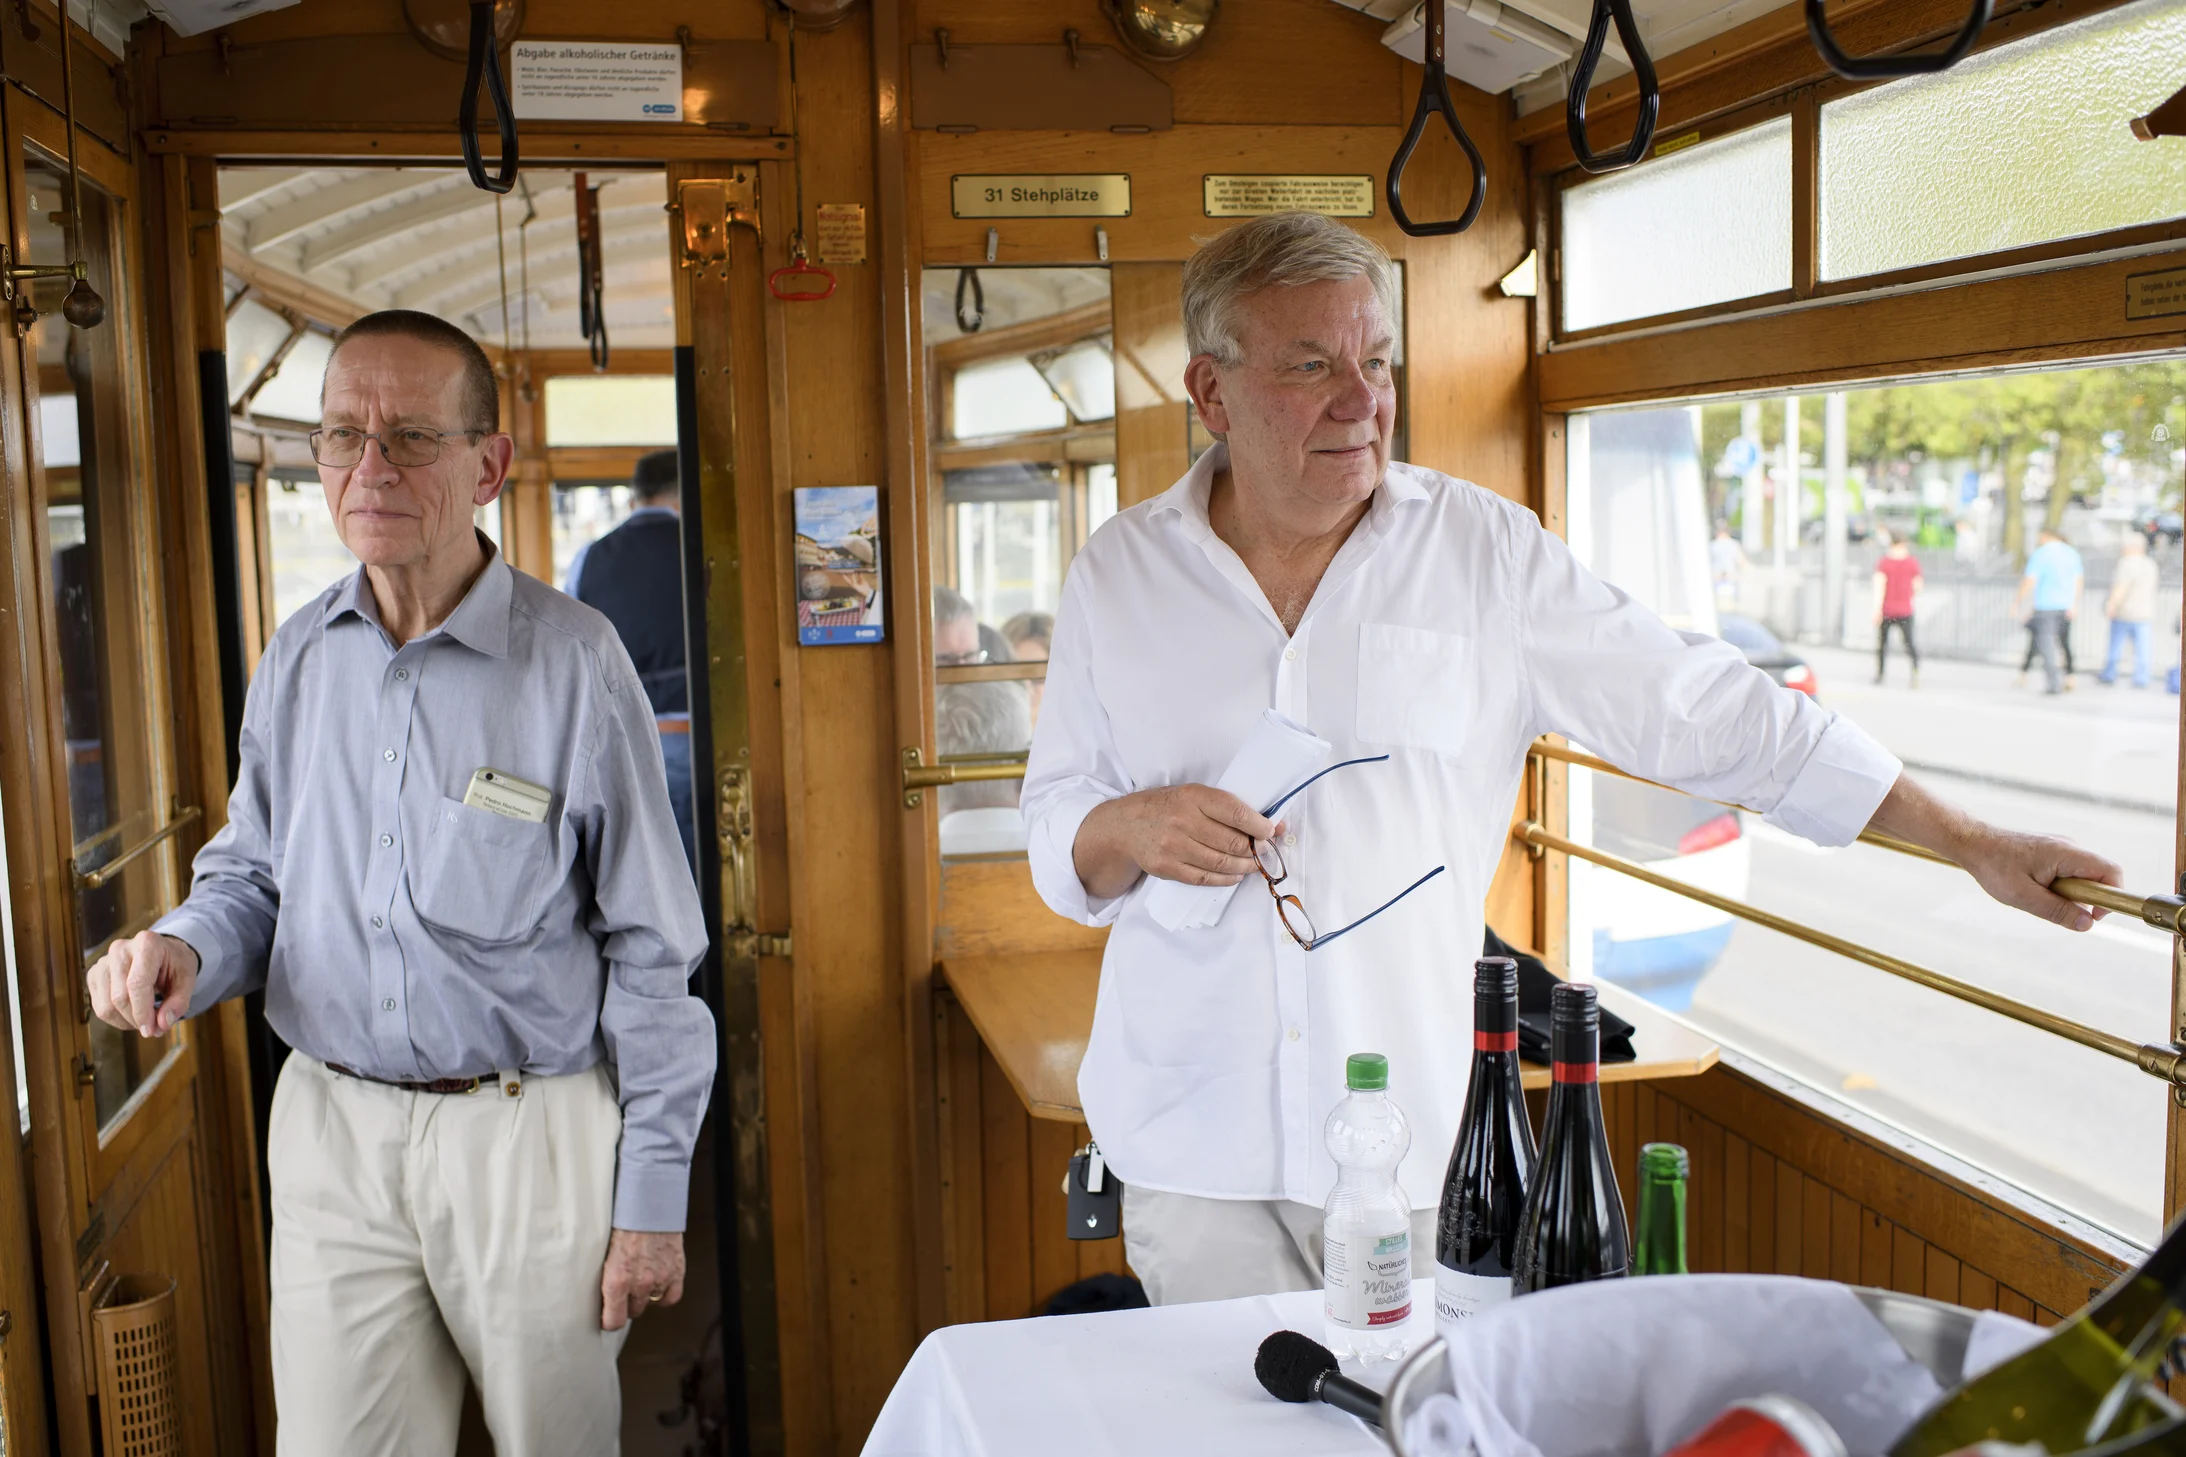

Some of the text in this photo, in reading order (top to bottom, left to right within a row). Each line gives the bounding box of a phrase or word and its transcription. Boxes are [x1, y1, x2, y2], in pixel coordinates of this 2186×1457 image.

[517, 48, 676, 61] Abgabe alkoholischer Getränke
[984, 188, 1100, 204] 31 Stehplätze
[1378, 1257, 1407, 1271] NATÜRLICHES
